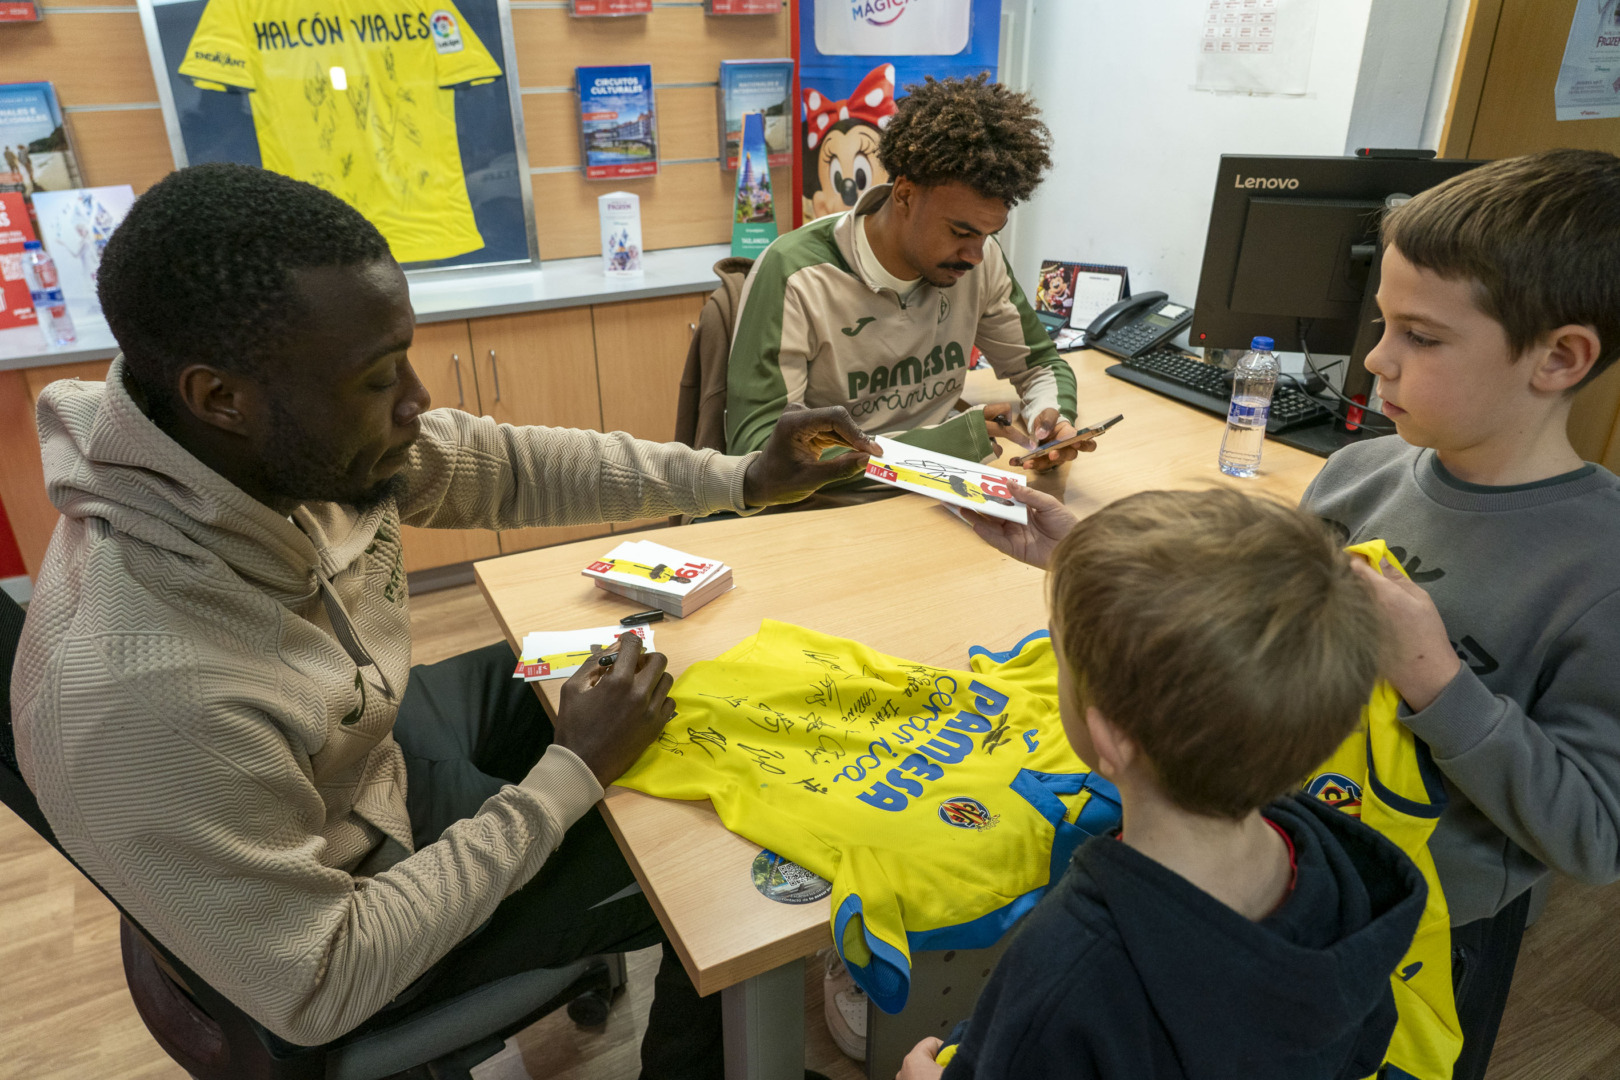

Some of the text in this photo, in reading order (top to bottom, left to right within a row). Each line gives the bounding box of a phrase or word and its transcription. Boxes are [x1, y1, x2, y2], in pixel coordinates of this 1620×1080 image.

[851, 0, 909, 21] MÁGIC
[254, 12, 430, 50] HALCÓN VIAJES
[590, 85, 643, 95] CULTURALES
[594, 77, 638, 87] CIRCUITOS
[1234, 174, 1299, 190] Lenovo
[847, 341, 966, 400] PAMESA
[980, 474, 1013, 499] 19
[675, 562, 707, 579] 19
[855, 679, 1010, 812] PAMESA
